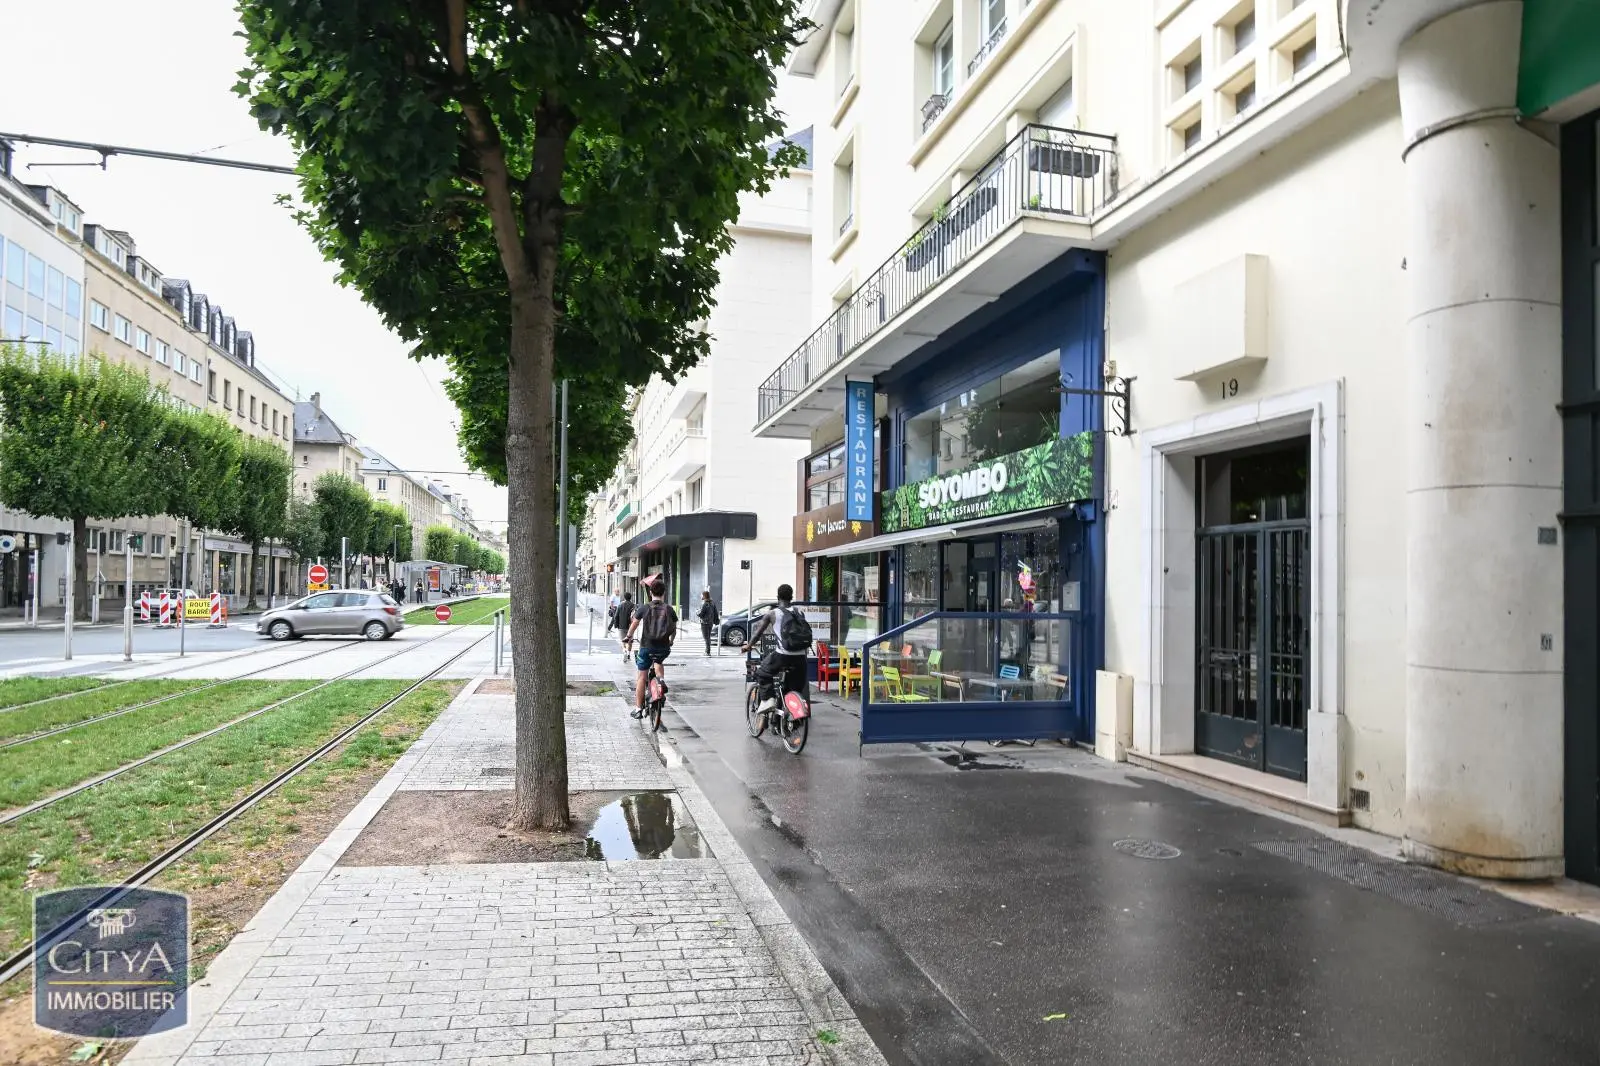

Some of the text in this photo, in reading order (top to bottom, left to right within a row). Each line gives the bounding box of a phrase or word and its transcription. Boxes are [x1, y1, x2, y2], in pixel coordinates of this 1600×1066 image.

[1221, 378, 1239, 400] 19
[854, 388, 867, 516] RESTAURANT
[918, 462, 1007, 508] SOYOMBO
[951, 500, 994, 517] RESTAURANT
